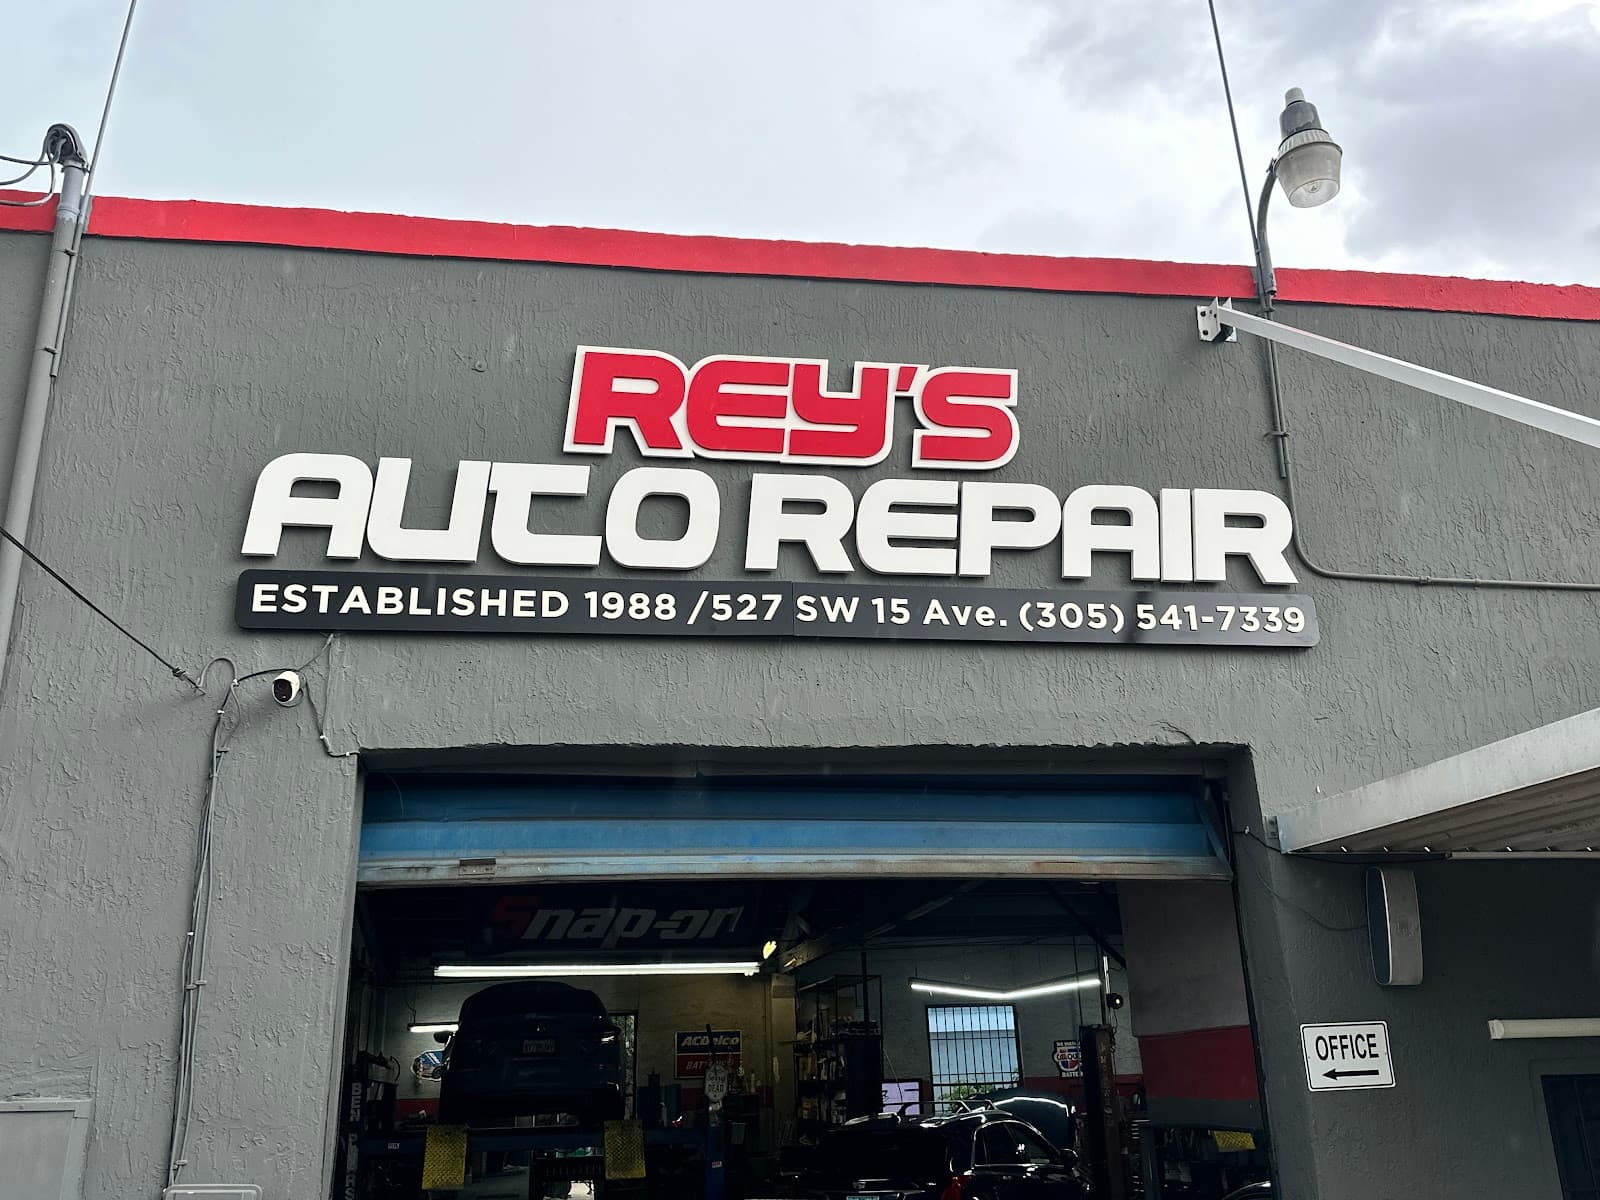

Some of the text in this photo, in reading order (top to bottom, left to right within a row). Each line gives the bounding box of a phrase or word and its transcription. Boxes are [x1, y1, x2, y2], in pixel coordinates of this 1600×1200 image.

[563, 345, 1020, 471] REY'S
[241, 453, 1298, 585] AUTO REPAIR
[252, 584, 569, 618] ESTABLISHED
[584, 591, 676, 620] 1988
[796, 595, 859, 623] SW
[871, 598, 910, 624] 15
[923, 599, 1007, 627] Ave.
[1018, 601, 1125, 634] (305)
[1136, 603, 1305, 633] 541-7339
[1315, 1033, 1379, 1061] OFFICE
